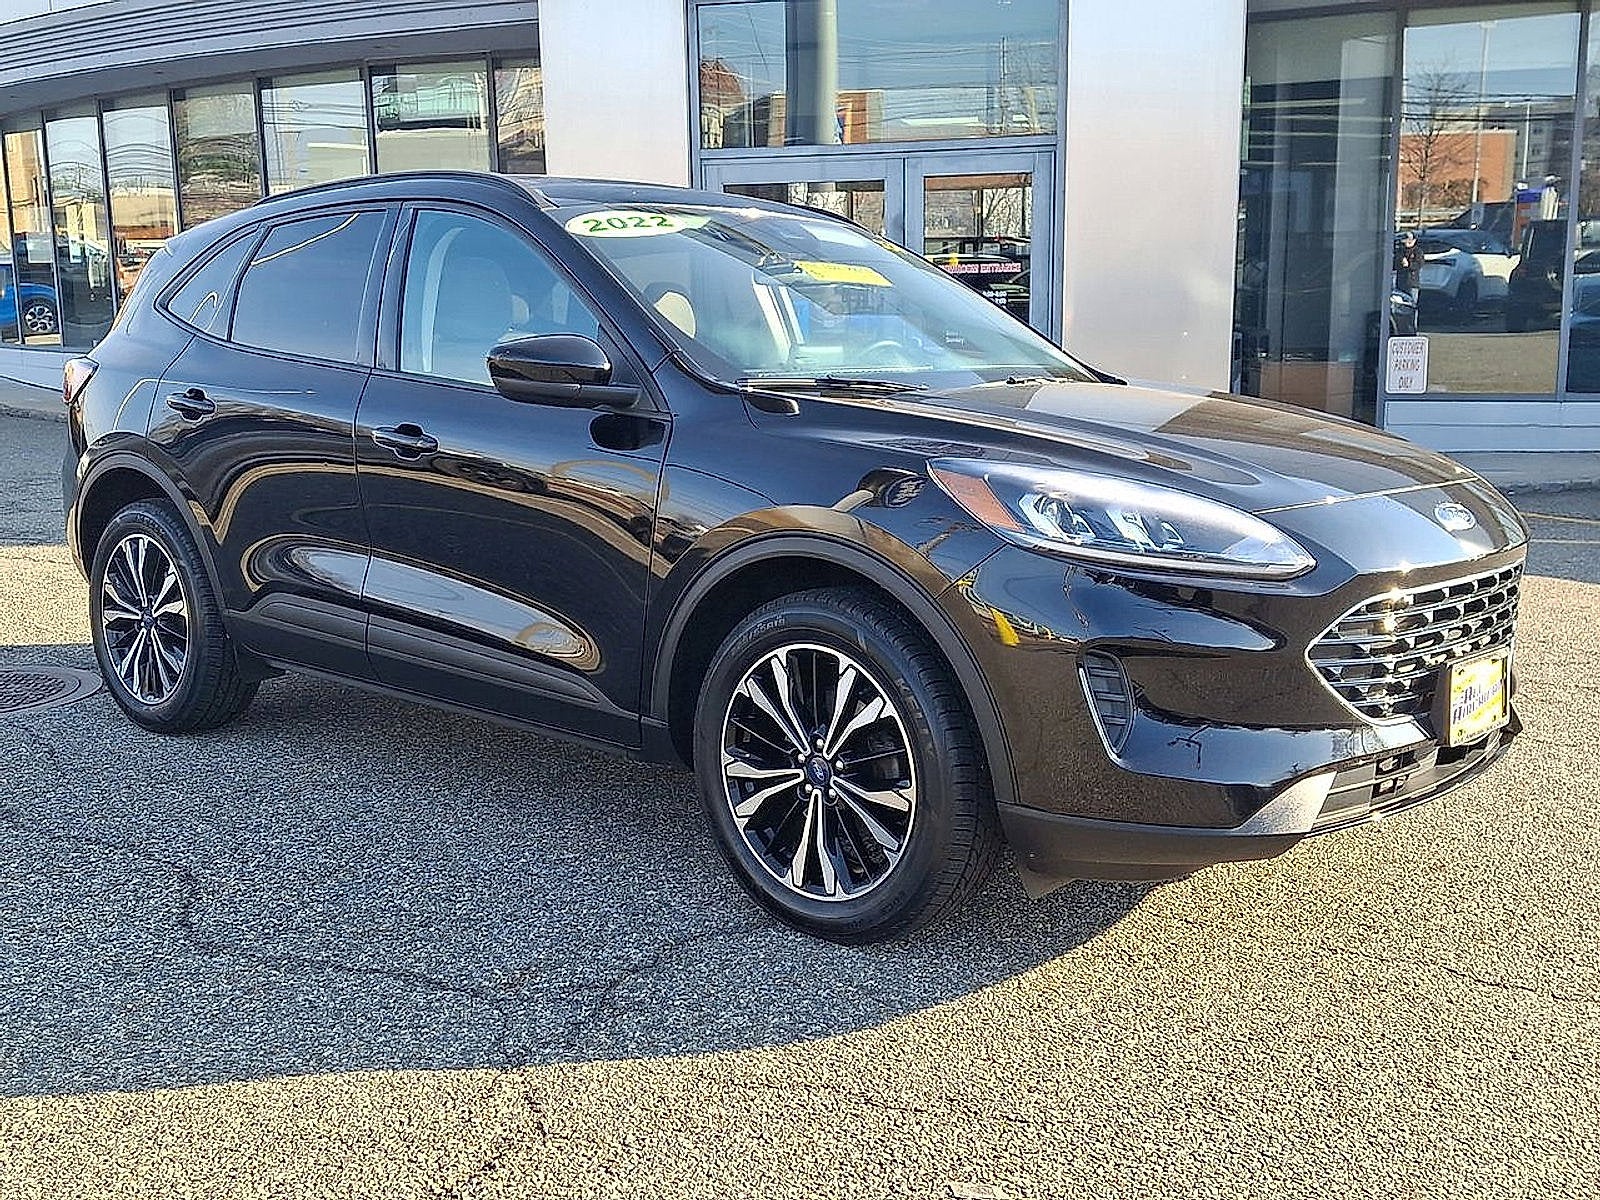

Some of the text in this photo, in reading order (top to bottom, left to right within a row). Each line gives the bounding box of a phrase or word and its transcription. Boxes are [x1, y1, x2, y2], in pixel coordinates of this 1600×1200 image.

[582, 216, 674, 233] 2022
[1391, 341, 1424, 355] CUSTOMER
[1391, 358, 1421, 371] PARKING
[1398, 375, 1414, 389] ONLY
